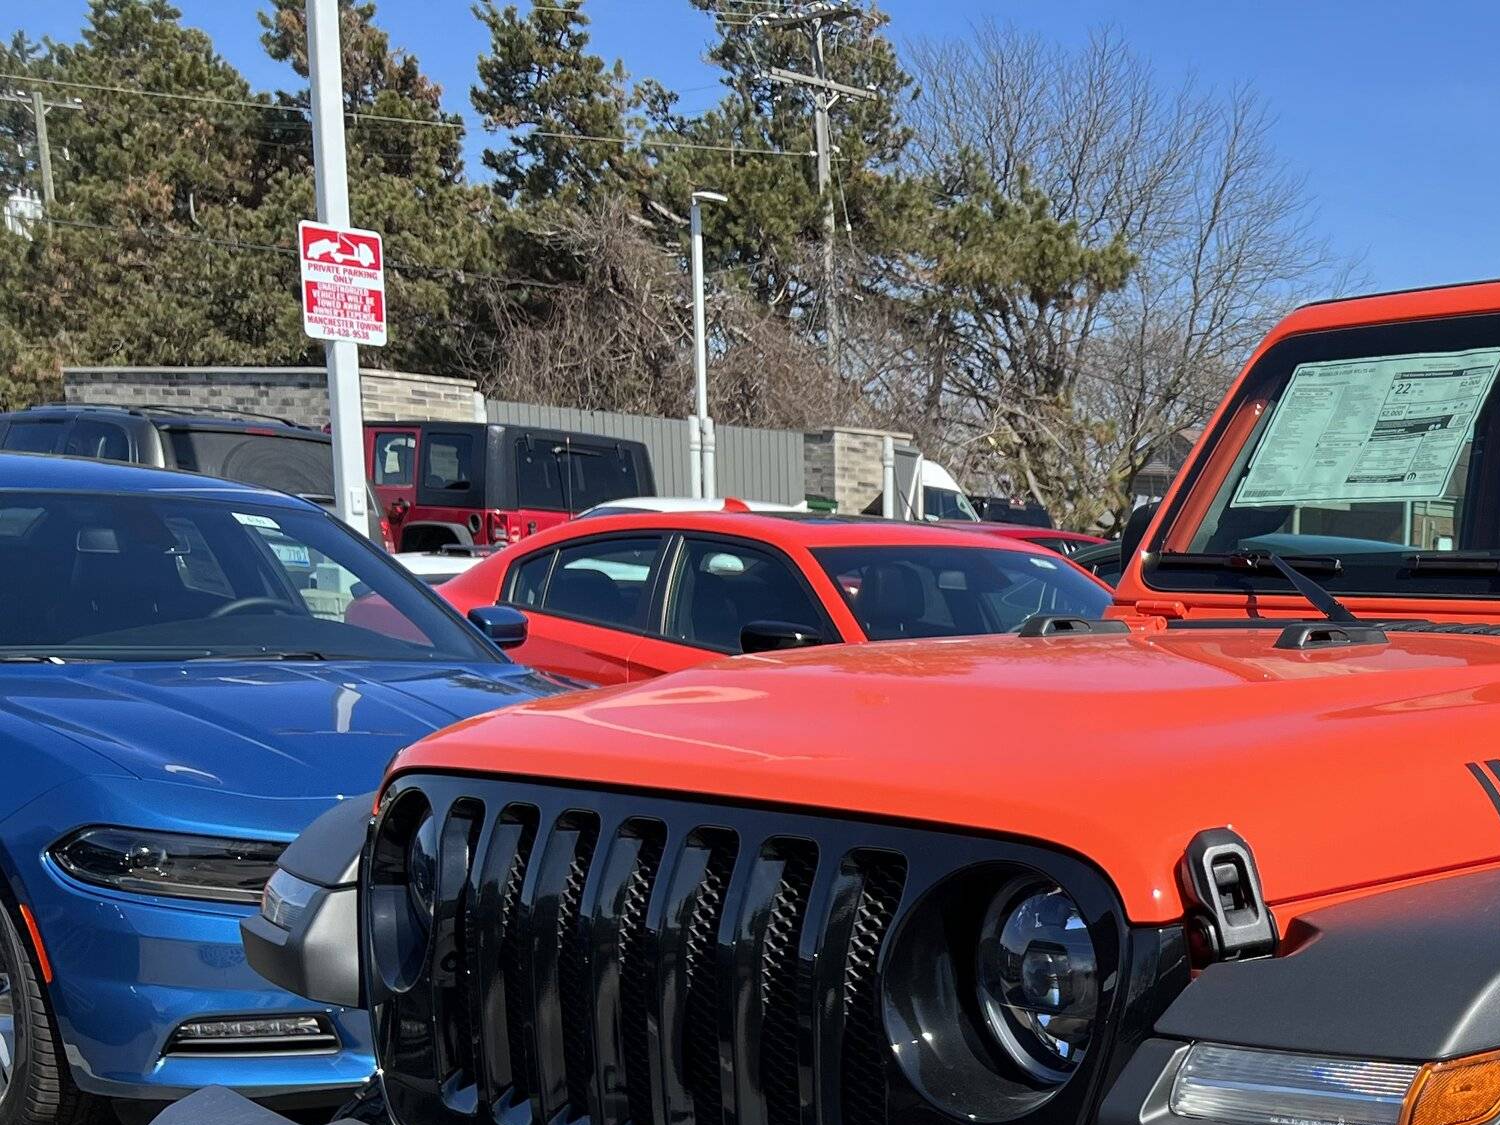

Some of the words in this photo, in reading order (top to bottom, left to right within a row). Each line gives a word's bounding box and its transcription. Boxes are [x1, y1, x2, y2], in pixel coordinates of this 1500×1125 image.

[307, 262, 340, 274] PRIVATE
[343, 267, 378, 280] PARKING
[333, 275, 354, 284] ONLY
[307, 315, 354, 329] MANCHESTER
[356, 321, 384, 333] TOWING
[1395, 383, 1412, 394] 22
